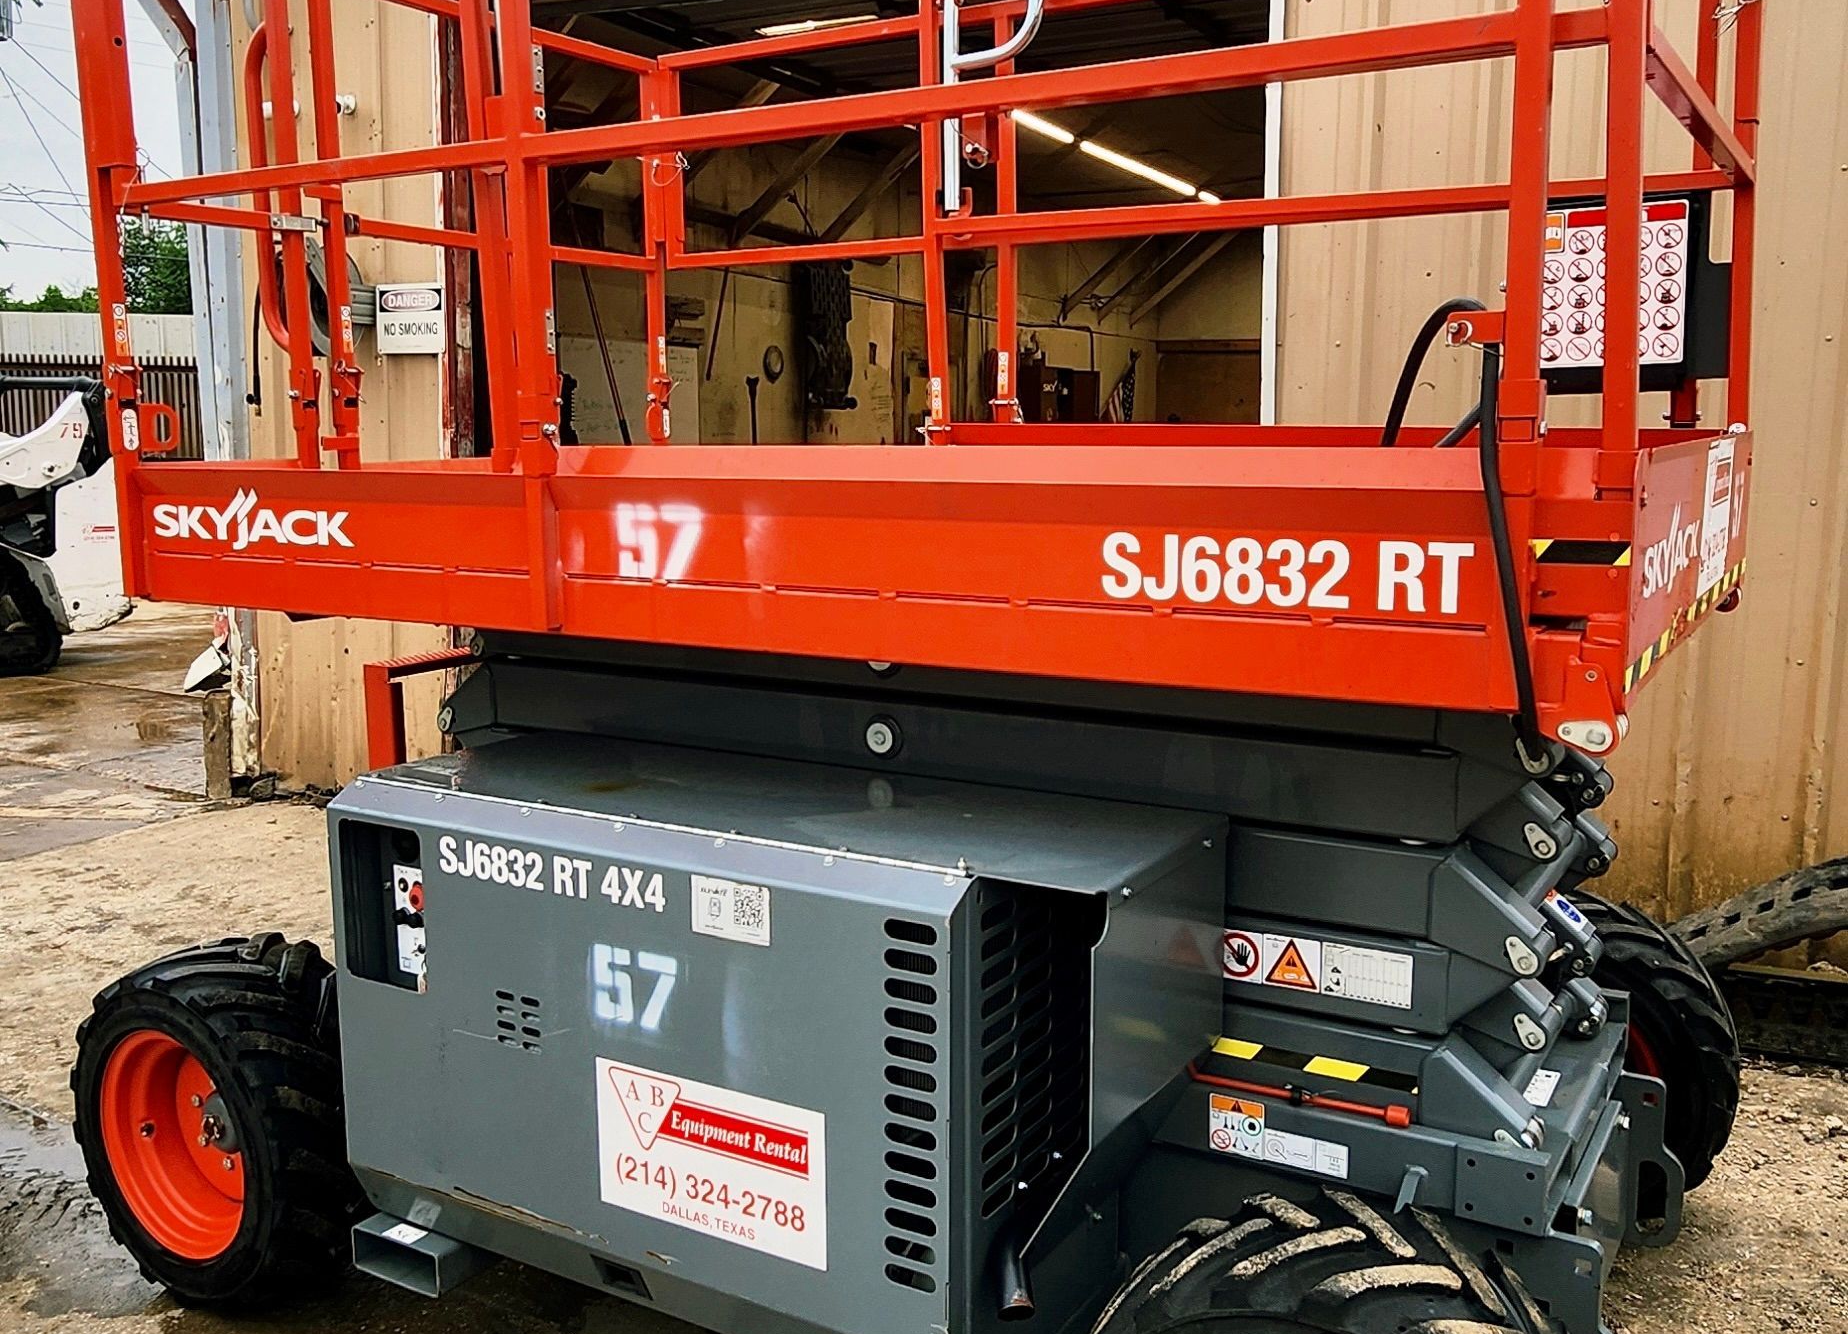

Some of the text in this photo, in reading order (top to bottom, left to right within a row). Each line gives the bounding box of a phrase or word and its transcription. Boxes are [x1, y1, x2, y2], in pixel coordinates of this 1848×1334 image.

[383, 322, 438, 336] NO SMOKING
[387, 293, 432, 307] DANGER
[60, 422, 82, 439] 79
[153, 487, 355, 550] SKYJACK
[615, 502, 702, 580] 57
[1643, 501, 1700, 599] SKYJACK
[1101, 531, 1475, 614] SJ6832 RT
[439, 835, 666, 913] SJ6832 RT 4X4
[593, 943, 677, 1029] 57
[671, 1110, 808, 1165] Equipment Rental
[616, 1152, 805, 1233] (214) 324-2788
[662, 1201, 756, 1241] DALLAS, TEXAS
